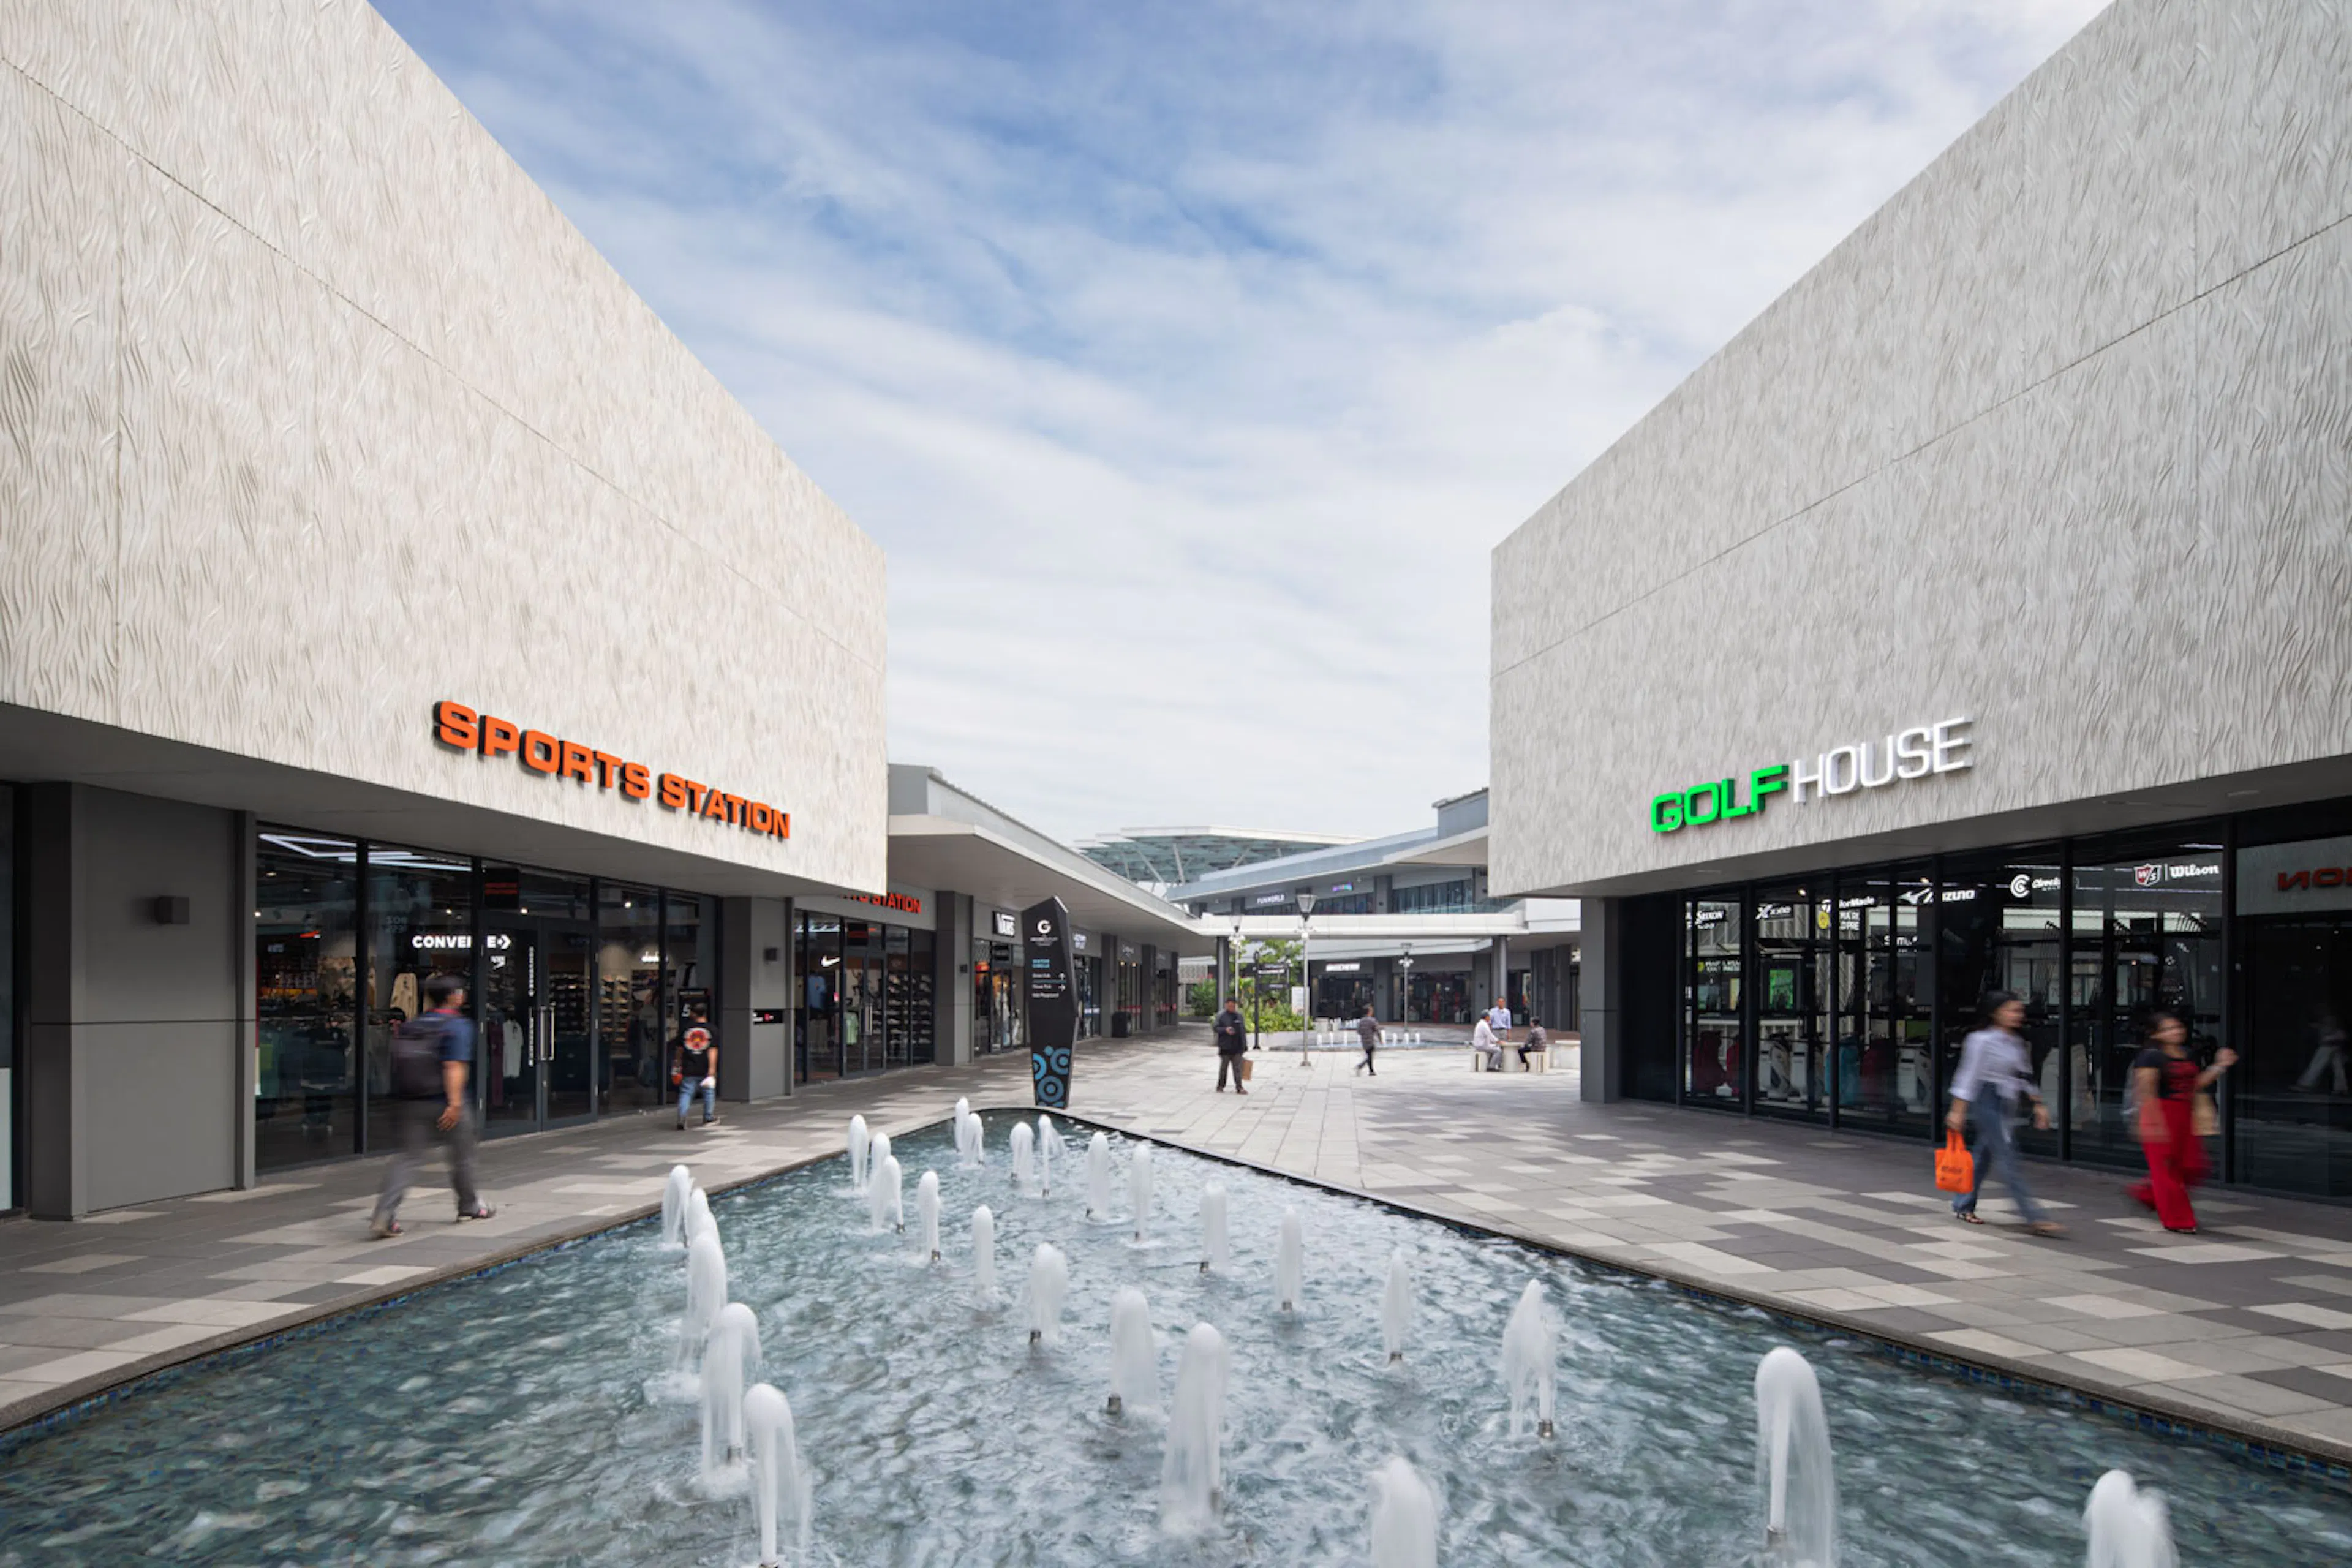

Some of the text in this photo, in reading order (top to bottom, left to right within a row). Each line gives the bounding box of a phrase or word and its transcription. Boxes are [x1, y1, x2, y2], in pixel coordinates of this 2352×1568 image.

[436, 700, 791, 839] SPORTS STATION
[1651, 715, 1973, 832] GOLF HOUSE
[2170, 864, 2220, 878] Wilson
